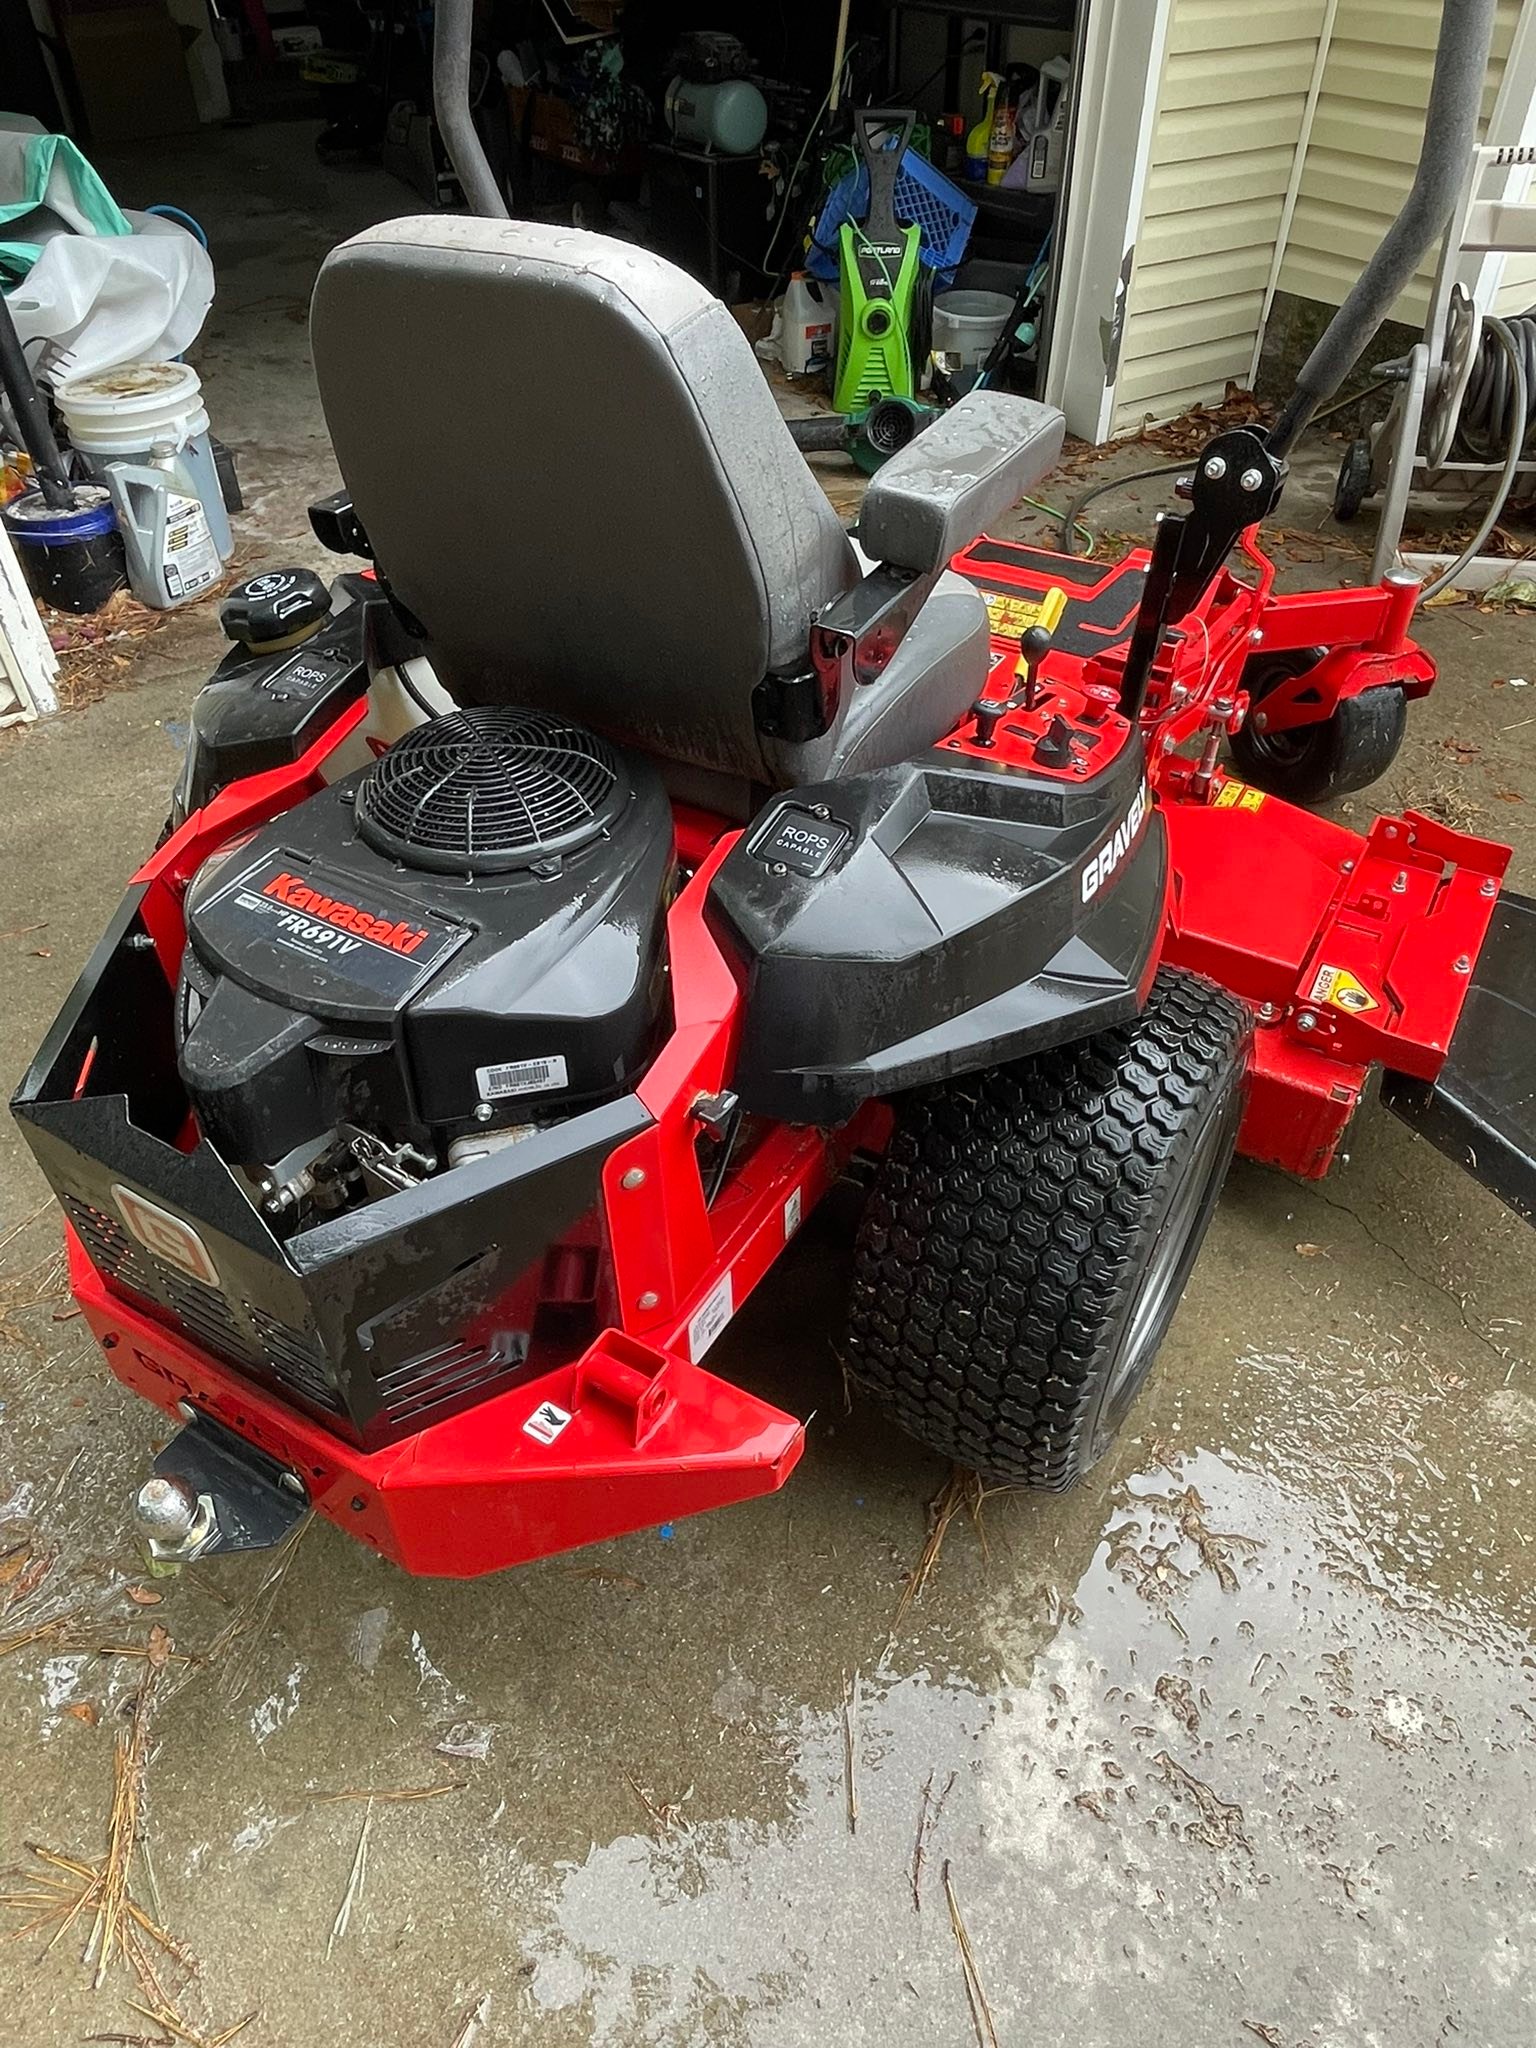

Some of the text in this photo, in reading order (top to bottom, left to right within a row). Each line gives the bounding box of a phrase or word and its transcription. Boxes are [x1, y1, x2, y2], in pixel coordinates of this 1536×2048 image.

[292, 665, 328, 683] ROPS
[776, 839, 822, 858] CAPABLE
[781, 825, 830, 849] ROPS
[262, 872, 430, 954] Kawasaki
[277, 914, 363, 955] FR691V
[1313, 969, 1334, 1001] ANGER
